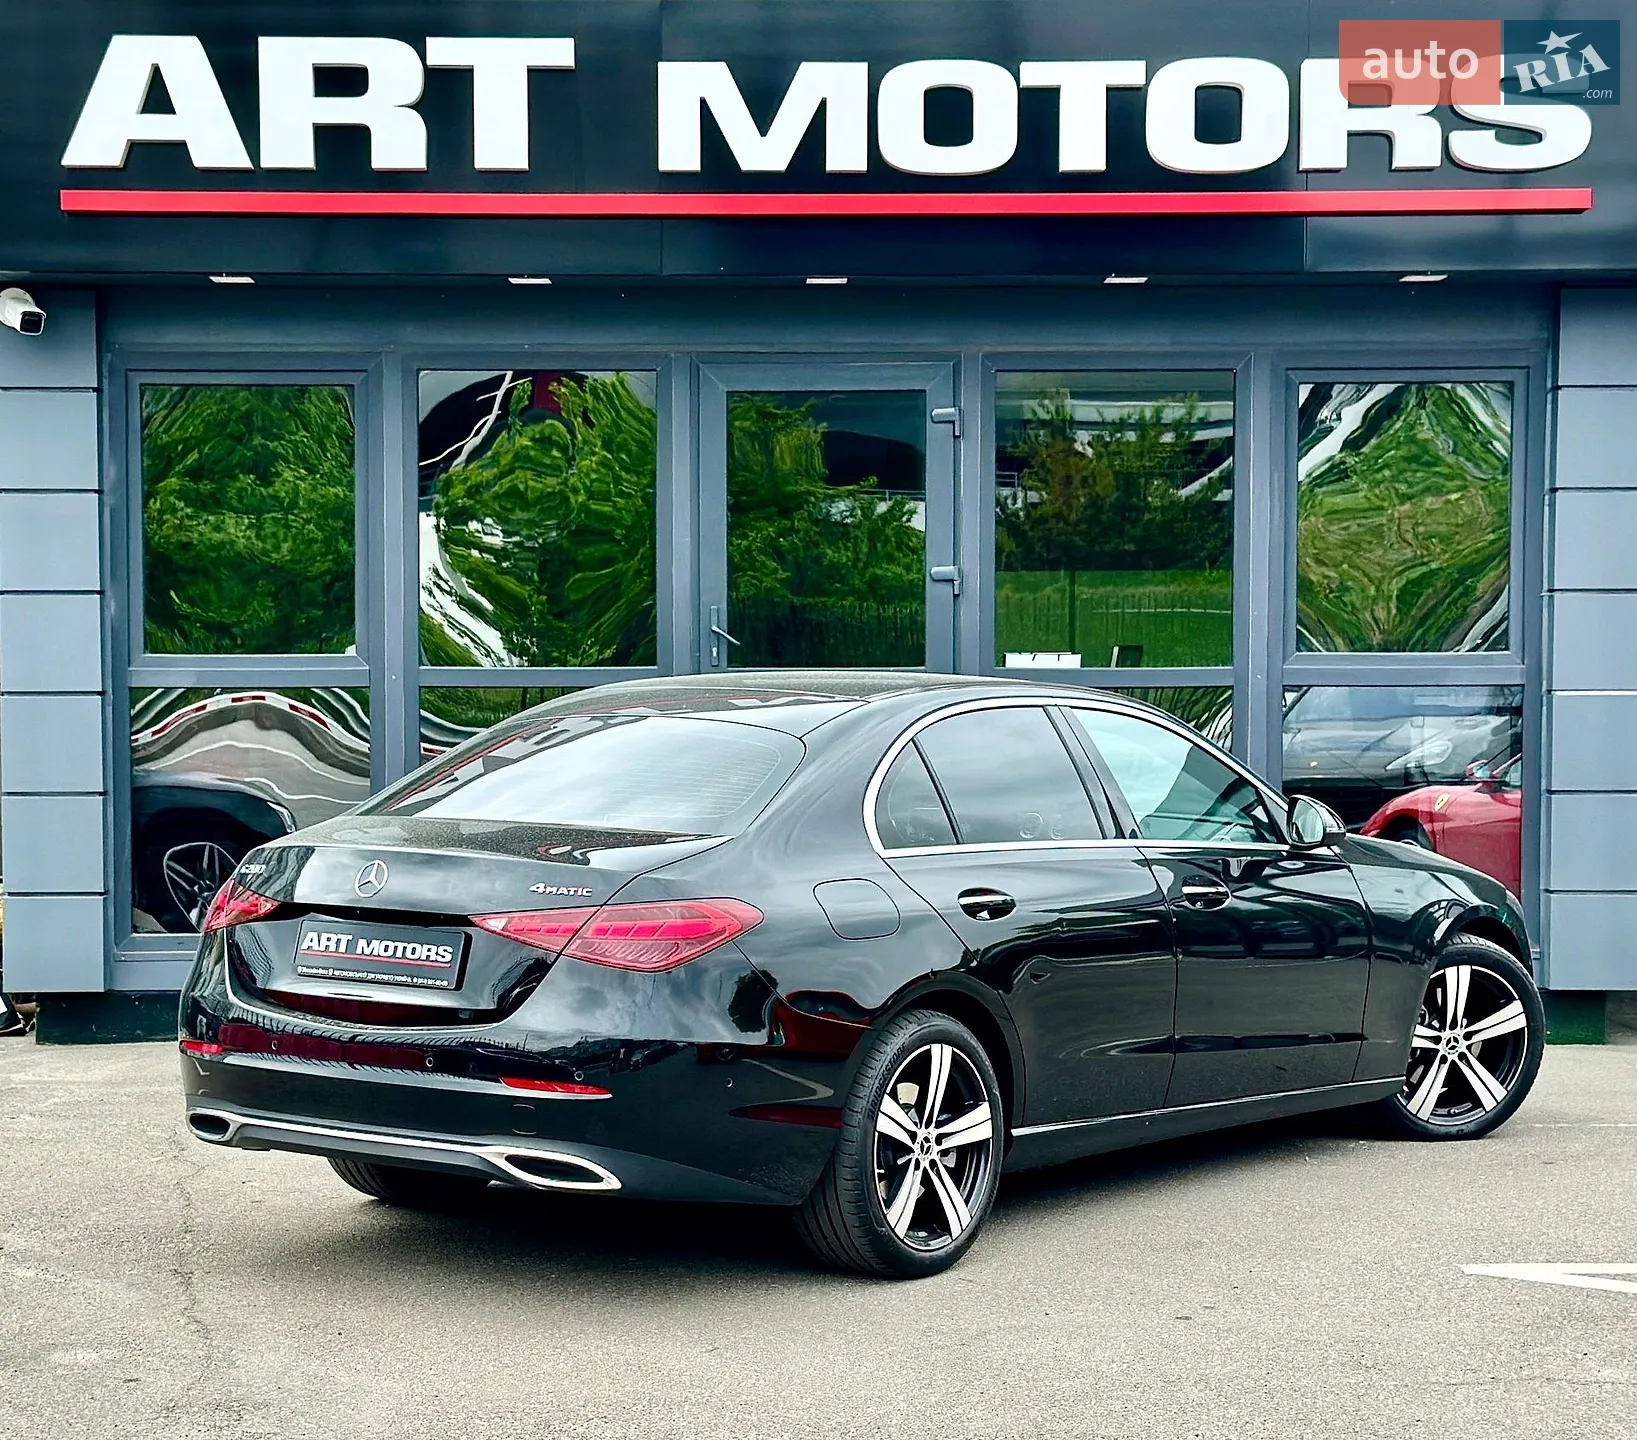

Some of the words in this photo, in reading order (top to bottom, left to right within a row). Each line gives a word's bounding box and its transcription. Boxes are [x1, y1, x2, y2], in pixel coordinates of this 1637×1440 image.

[60, 35, 576, 172] ART
[656, 56, 1593, 174] MOTORS
[529, 882, 593, 897] 4MATIC
[300, 931, 353, 953] ART
[355, 938, 454, 963] MOTORS
